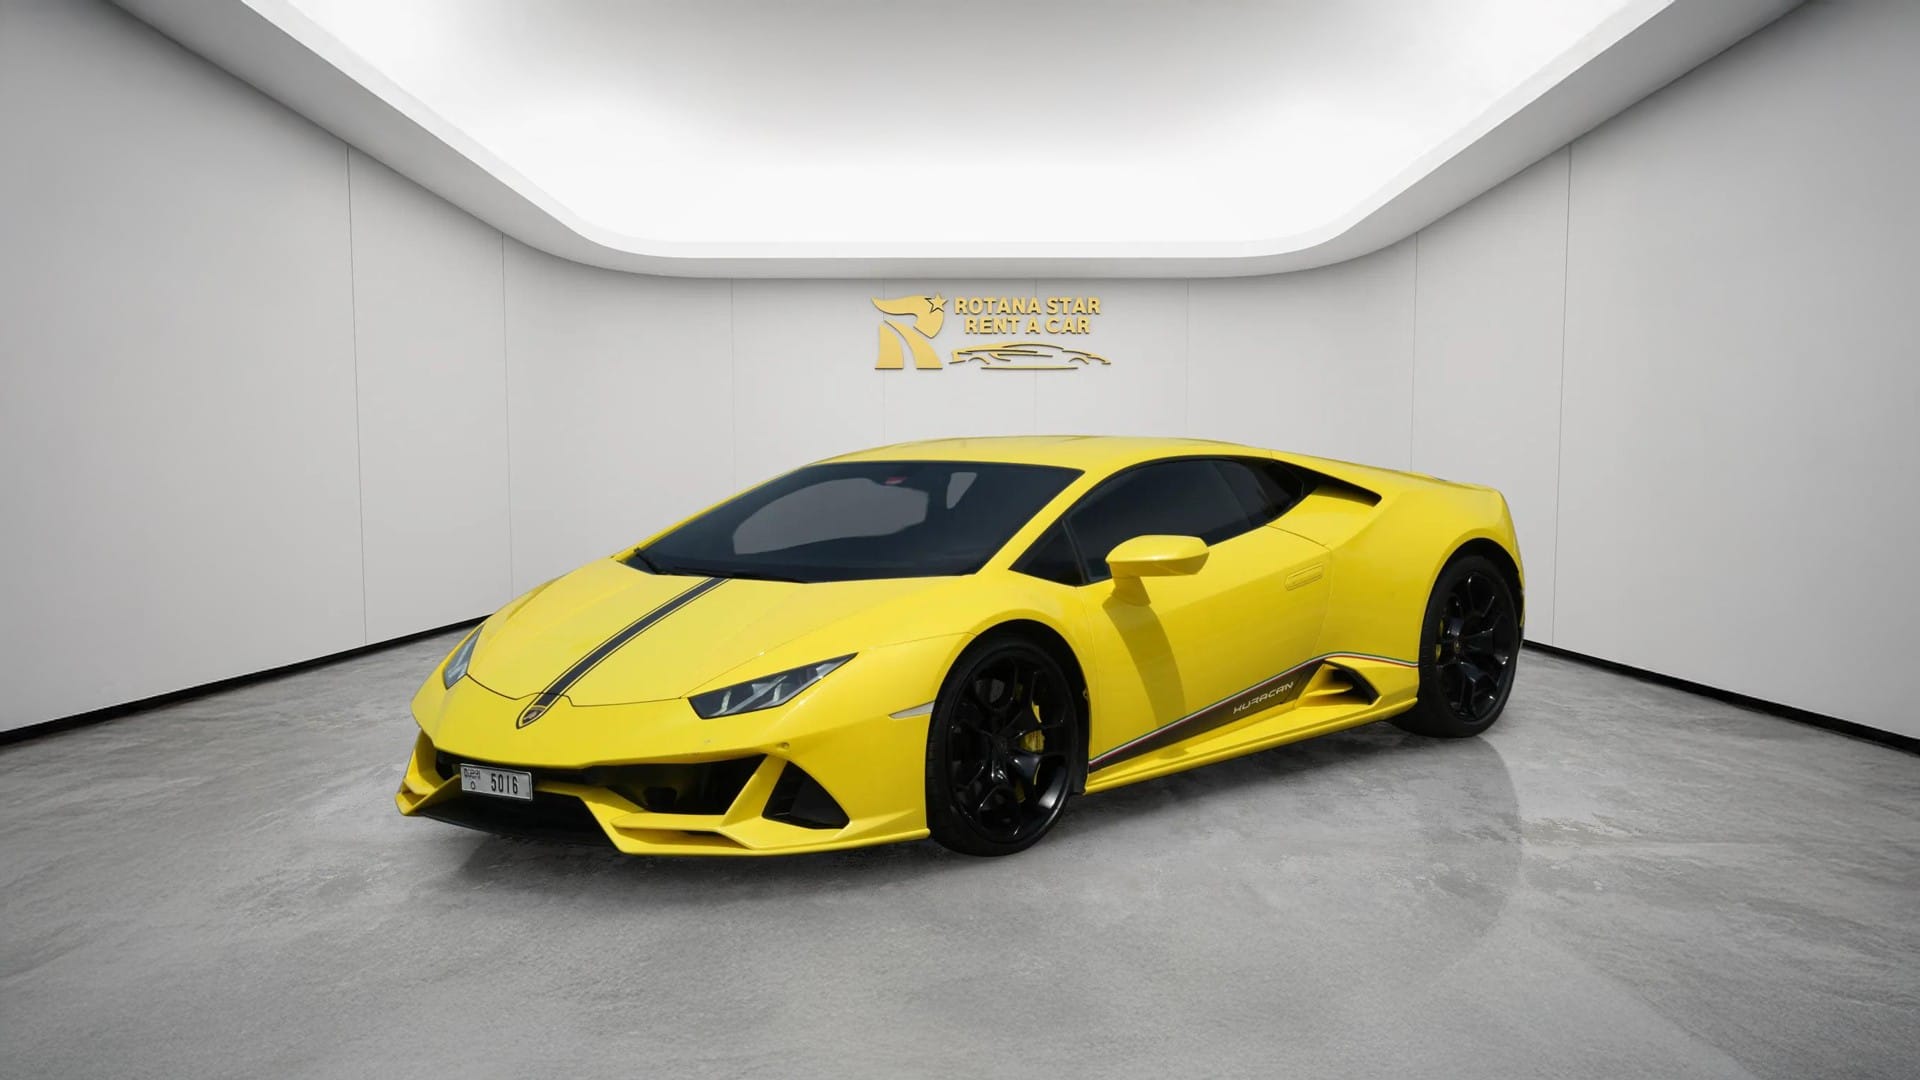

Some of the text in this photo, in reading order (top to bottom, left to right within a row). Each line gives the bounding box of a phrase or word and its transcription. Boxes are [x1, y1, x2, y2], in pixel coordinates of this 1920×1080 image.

[955, 297, 1101, 315] ROTANA STAR
[965, 317, 1090, 334] RENT A CAR
[1233, 681, 1294, 714] HURACAN
[491, 773, 518, 794] 5016
